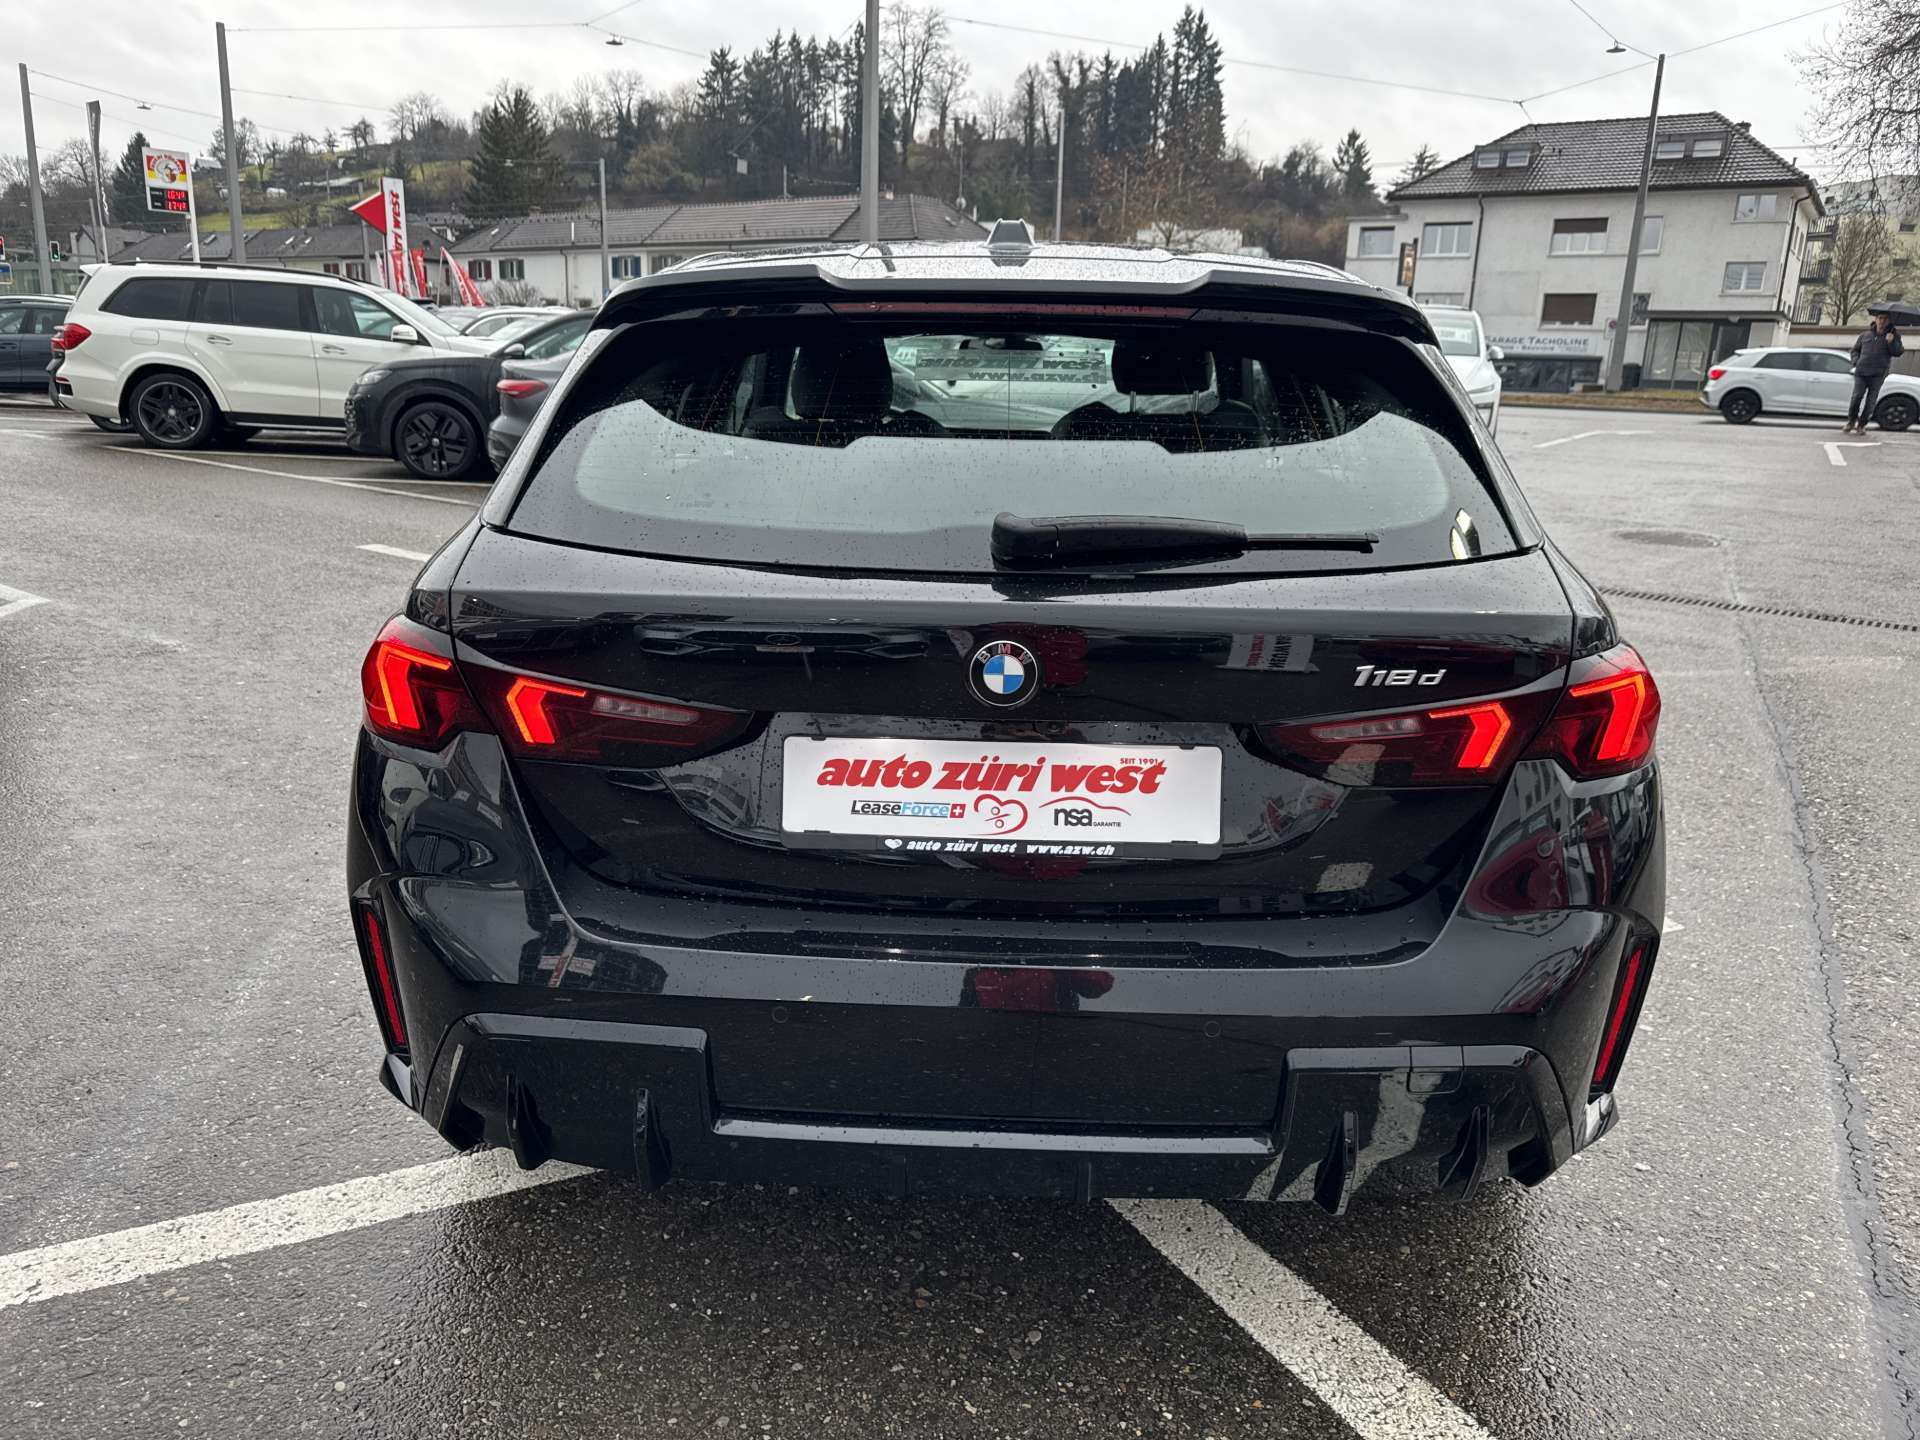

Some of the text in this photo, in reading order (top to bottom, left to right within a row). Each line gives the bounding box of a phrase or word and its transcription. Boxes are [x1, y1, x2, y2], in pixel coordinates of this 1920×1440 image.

[1528, 336, 1589, 346] TACHOLINE
[976, 643, 1034, 665] BMW
[1119, 757, 1159, 766] SEIT 1991
[816, 753, 1168, 795] auto züri west
[850, 799, 950, 817] LeaseForce
[1053, 807, 1122, 828] nsa GARANTIE
[906, 839, 1116, 856] auto züri west www.azw.ch
